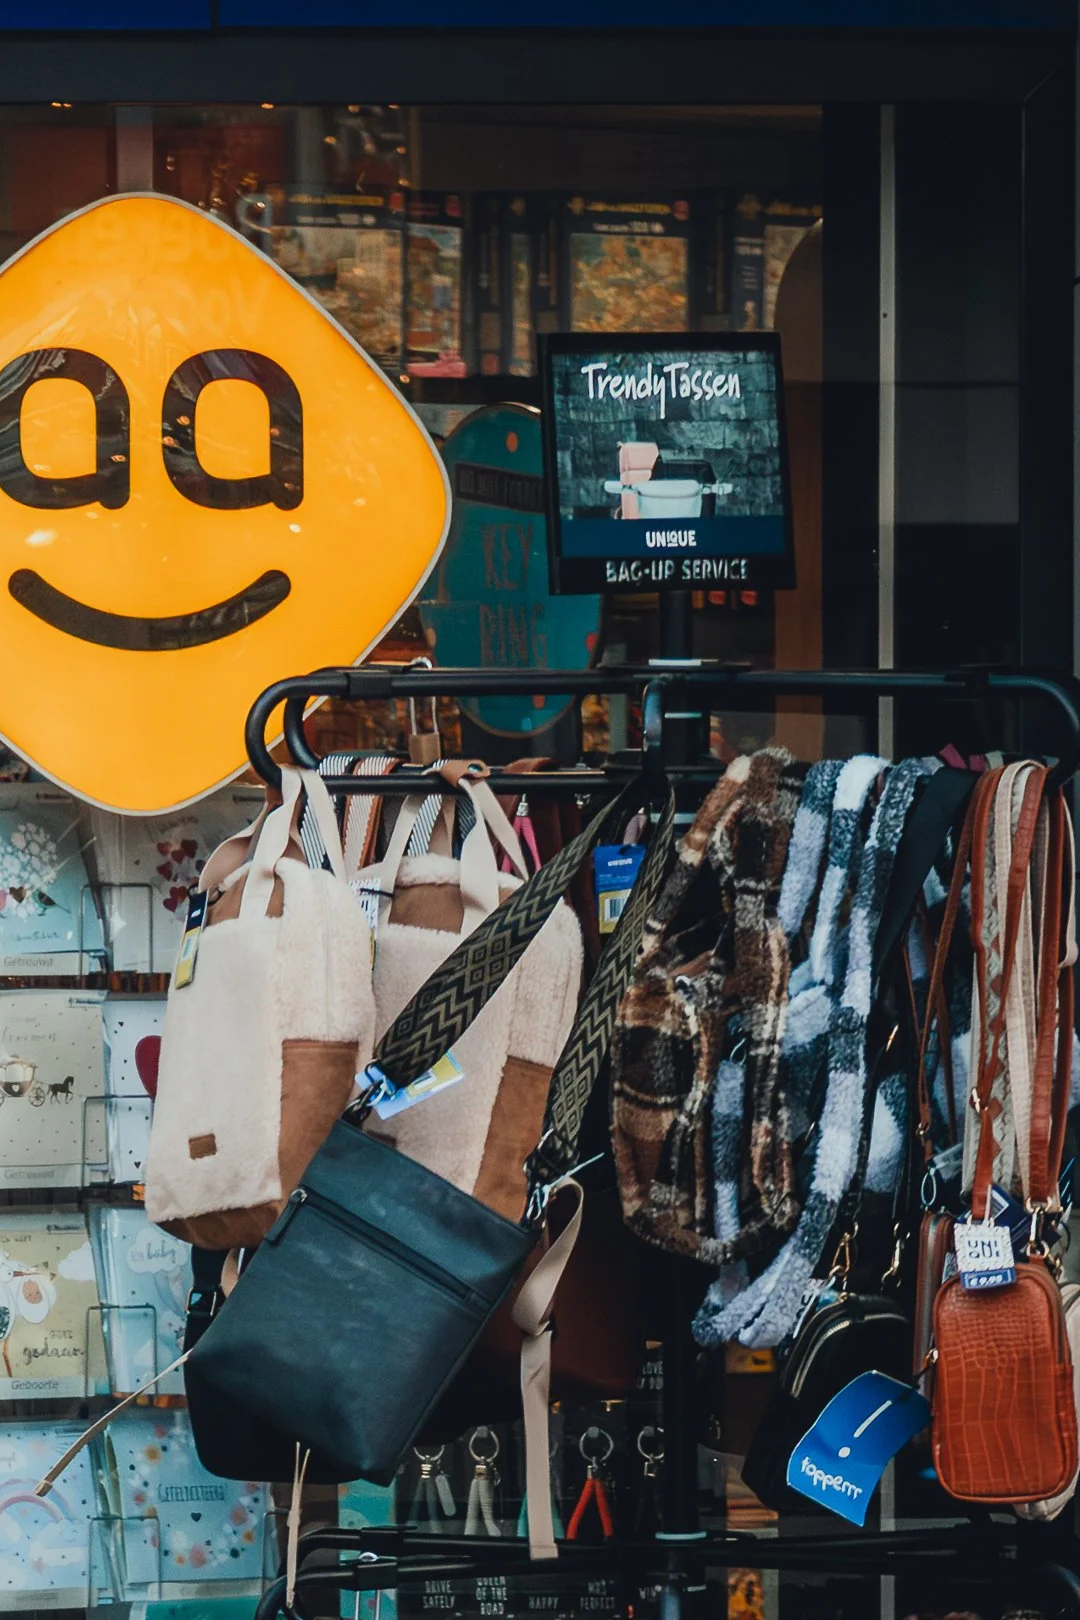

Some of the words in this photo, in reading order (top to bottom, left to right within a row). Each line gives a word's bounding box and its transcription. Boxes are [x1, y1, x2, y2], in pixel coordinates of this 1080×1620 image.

[646, 530, 697, 548] UNIQUE
[480, 521, 534, 591] KEY
[681, 559, 749, 580] SERVICE
[425, 1580, 453, 1594] DRIVE
[475, 1587, 490, 1601] OF
[492, 1587, 507, 1601] THE
[423, 1595, 456, 1610] SAFELY
[480, 1602, 505, 1616] ROAD
[528, 1596, 559, 1610] HAPPY
